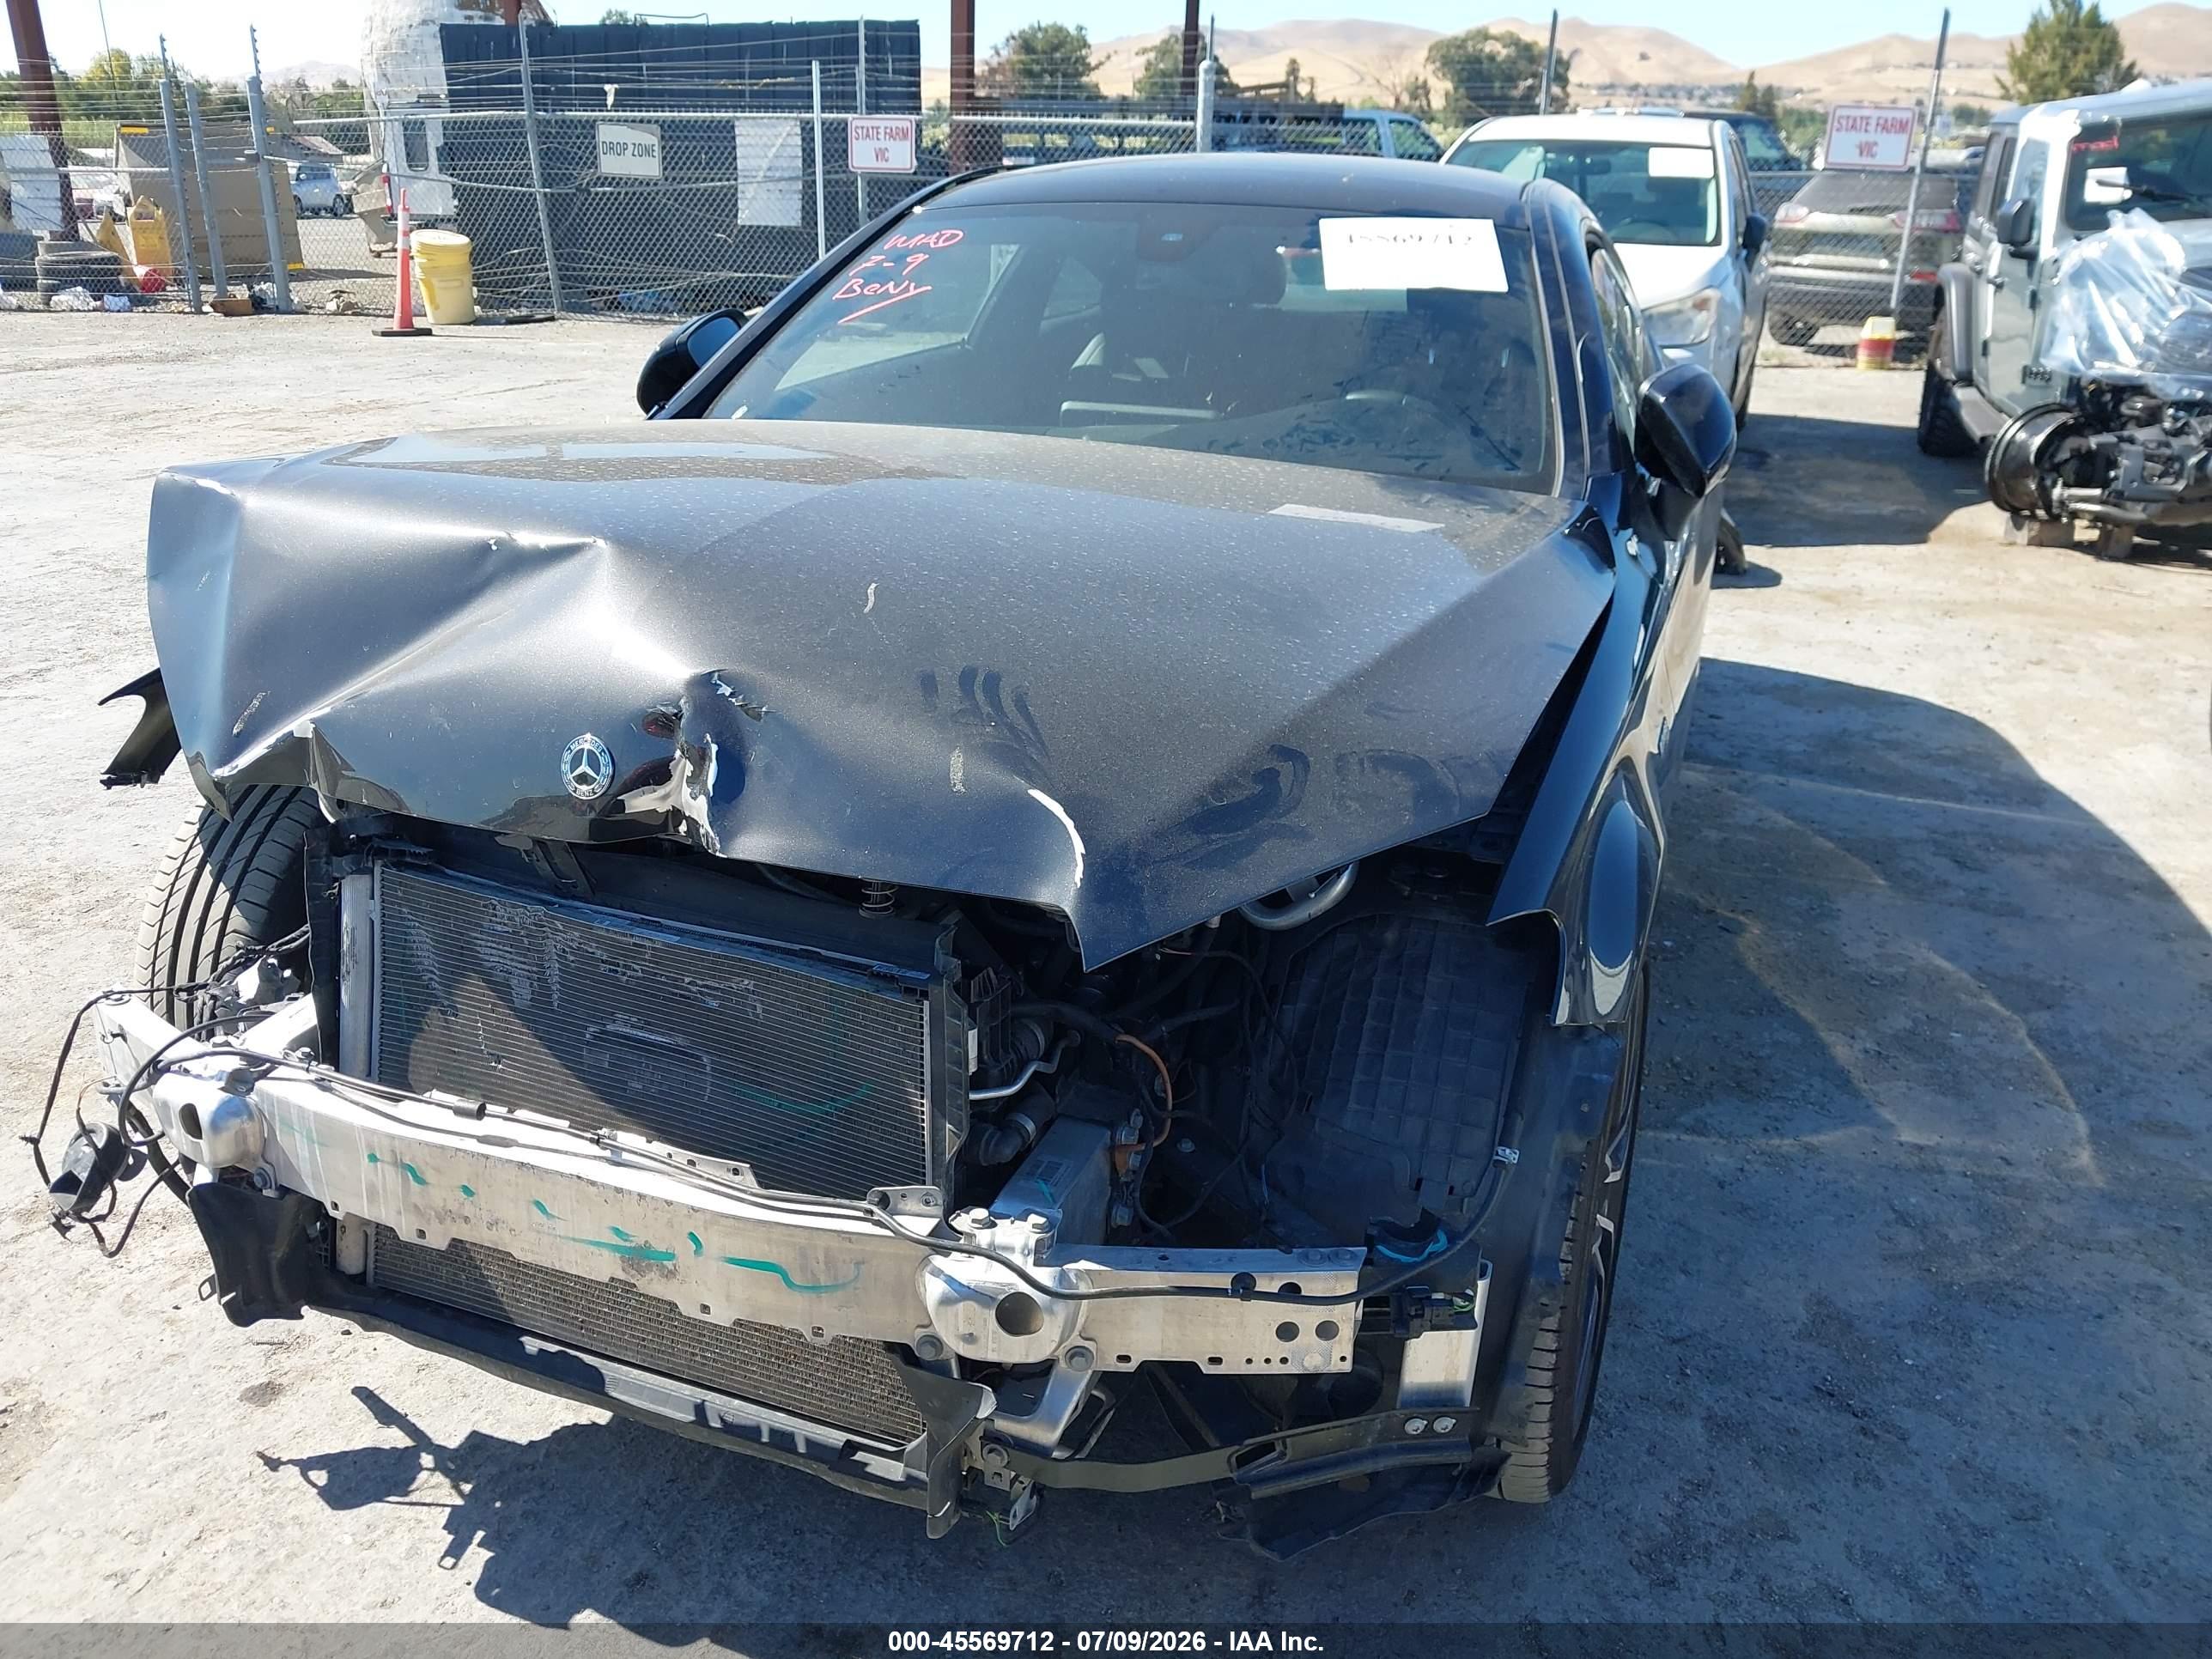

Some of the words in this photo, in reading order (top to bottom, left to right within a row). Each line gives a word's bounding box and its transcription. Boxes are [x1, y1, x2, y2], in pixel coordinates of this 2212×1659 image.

[1835, 114, 1872, 133] STATE
[1875, 116, 1910, 134] FARM
[854, 125, 881, 141] STATE
[884, 125, 909, 142] FARM
[601, 141, 629, 156] DROP
[631, 142, 657, 159] ZONE
[873, 147, 890, 163] VIC
[1858, 140, 1879, 158] VIC
